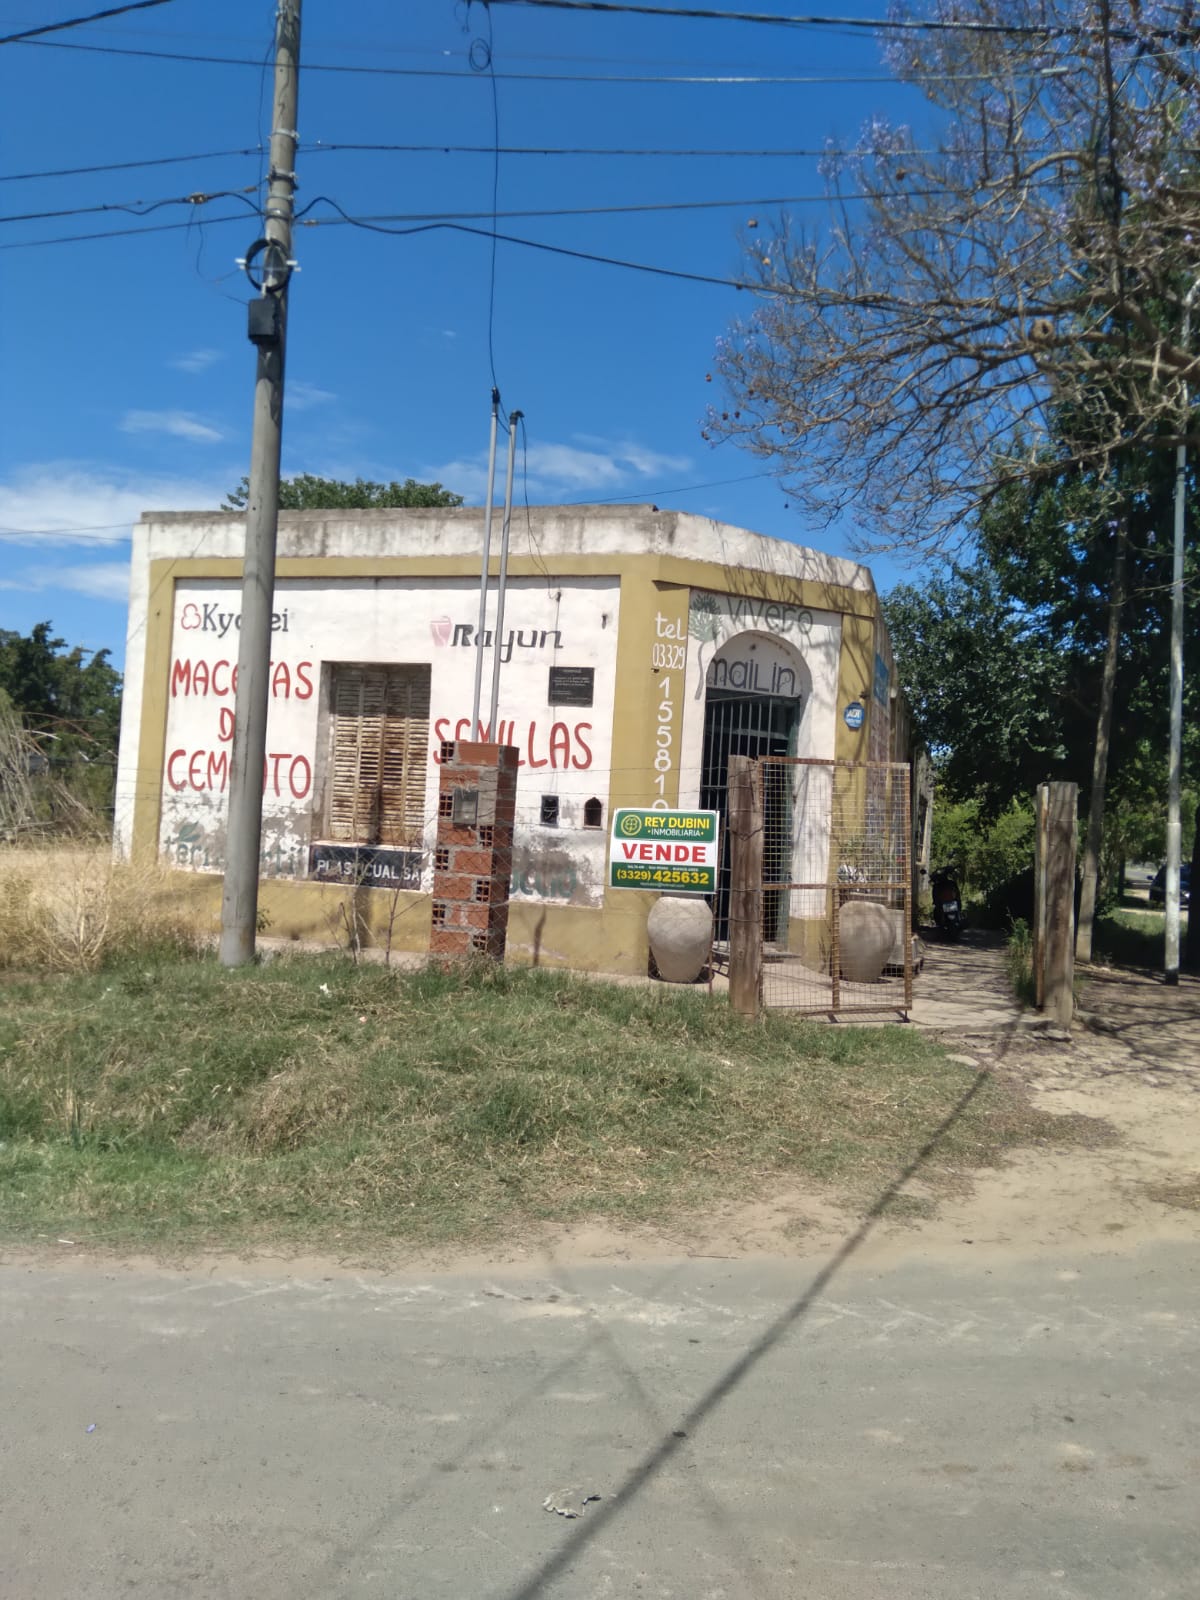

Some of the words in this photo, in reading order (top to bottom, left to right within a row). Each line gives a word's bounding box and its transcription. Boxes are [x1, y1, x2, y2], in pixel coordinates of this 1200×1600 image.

[201, 602, 290, 639] Kyei
[450, 623, 564, 664] Rayun
[652, 642, 686, 670] 03329
[171, 657, 314, 700] MACAS
[217, 706, 237, 742] D
[166, 748, 312, 800] CEMTO
[644, 816, 666, 828] REY
[668, 817, 710, 830] DUBINI
[651, 828, 701, 837] INMOBILIARIA
[621, 842, 707, 863] VENDE
[616, 868, 651, 882] (3329)
[652, 870, 710, 885] 425632
